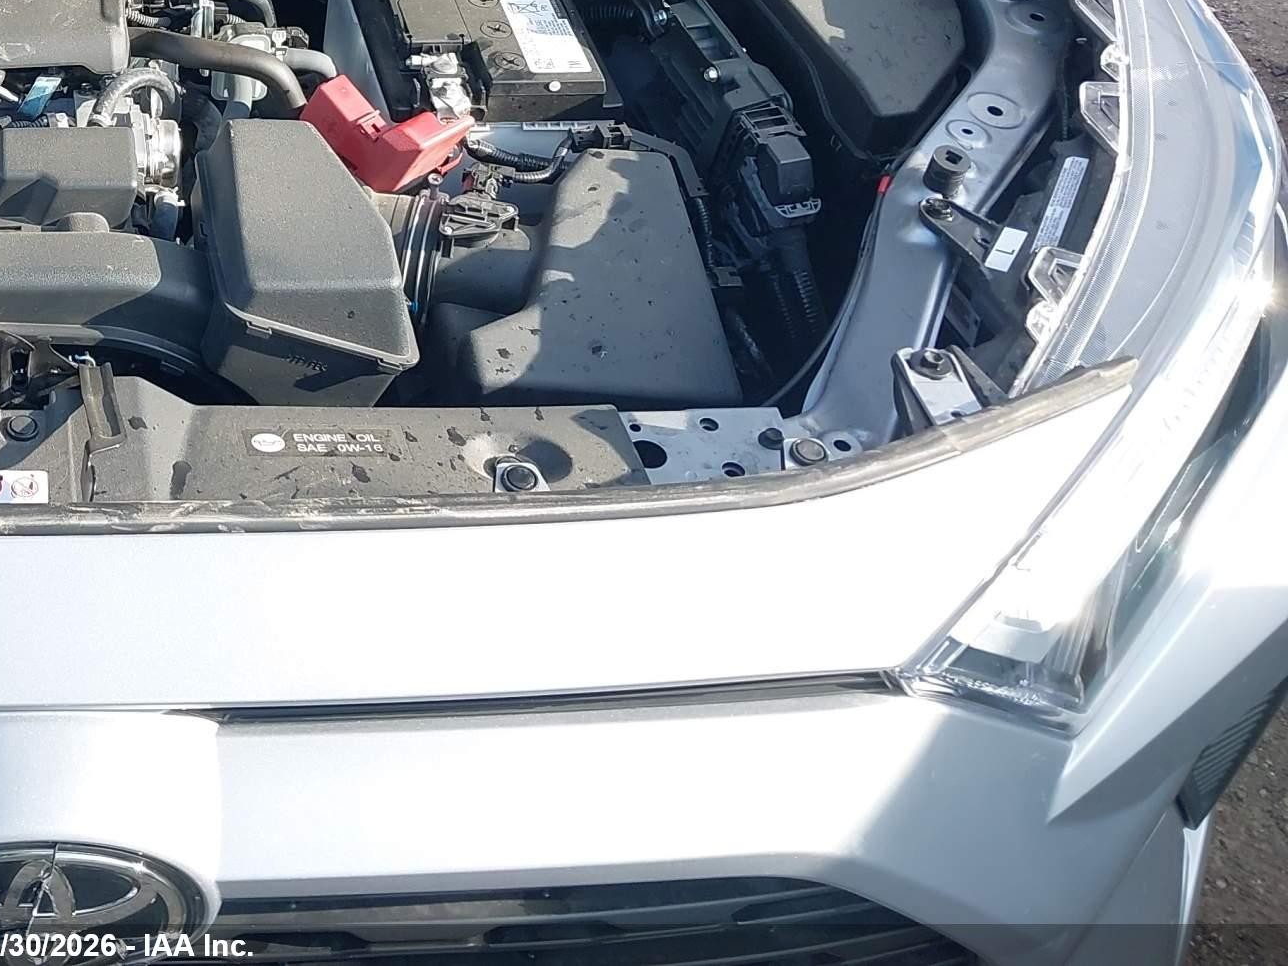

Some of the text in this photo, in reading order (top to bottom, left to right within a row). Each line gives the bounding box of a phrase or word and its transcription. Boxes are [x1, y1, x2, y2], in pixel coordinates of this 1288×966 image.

[293, 433, 380, 442] ENGINE OIL
[297, 443, 385, 452] SAE 0W-16
